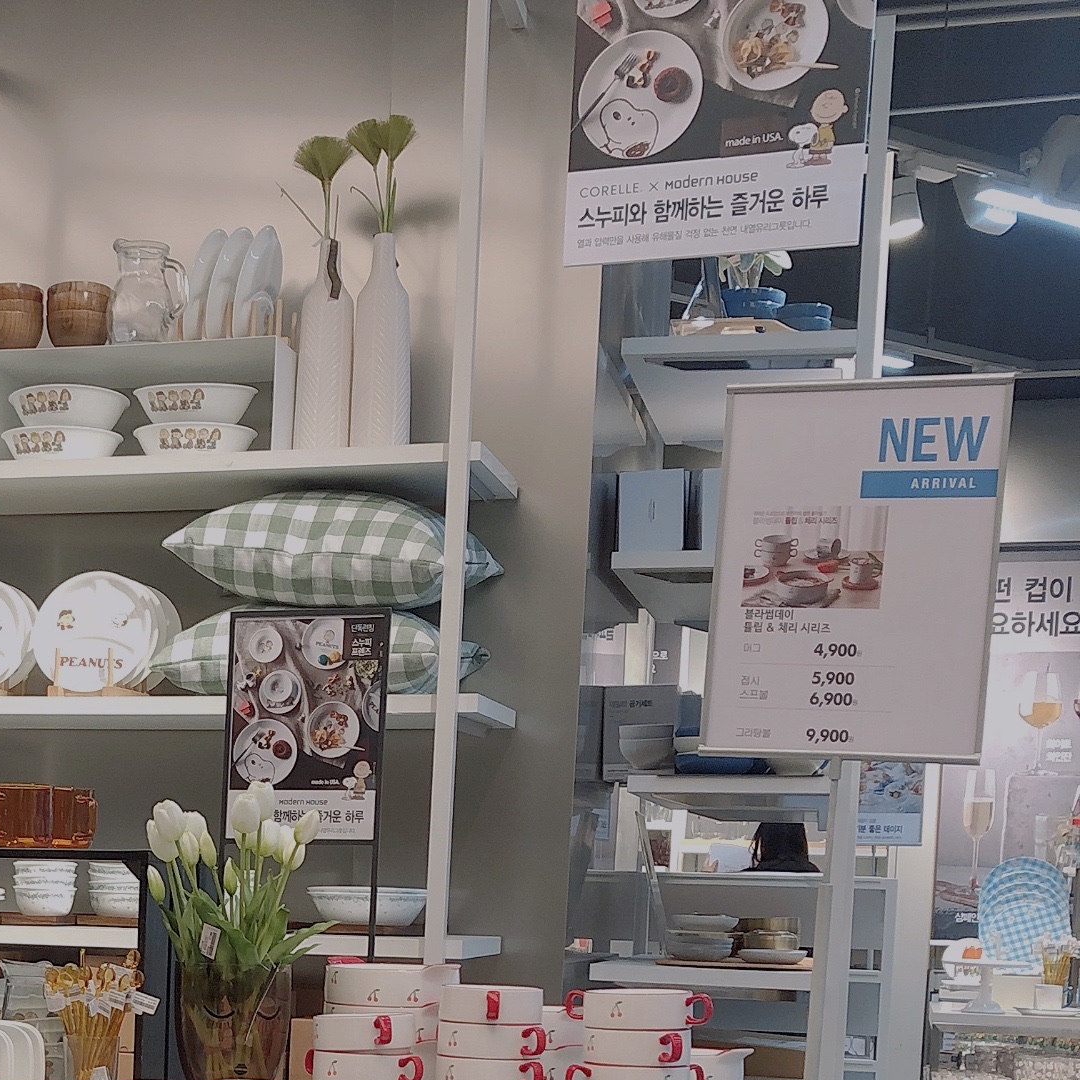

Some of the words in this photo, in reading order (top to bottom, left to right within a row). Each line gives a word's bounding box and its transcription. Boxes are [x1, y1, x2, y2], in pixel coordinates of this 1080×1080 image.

[725, 137, 751, 147] made
[752, 135, 761, 143] in
[577, 201, 647, 228] 스누피와
[653, 195, 724, 223] 함께하는
[730, 188, 785, 217] 즐거운
[792, 184, 829, 210] 하루
[626, 233, 650, 244] 사용해
[685, 228, 701, 239] 걱정
[721, 225, 738, 236] 천연
[878, 416, 991, 463] NEW
[910, 477, 977, 489] ARRIVAL
[1025, 576, 1073, 604] 컵이
[745, 608, 795, 621] 블라썸데이
[766, 623, 775, 632] &
[778, 622, 798, 634] 체리
[800, 623, 831, 634] 시리즈
[351, 638, 373, 647] 스누피
[811, 671, 855, 687] 5,900
[344, 810, 365, 824] 하루
[868, 824, 882, 834] 좋은
